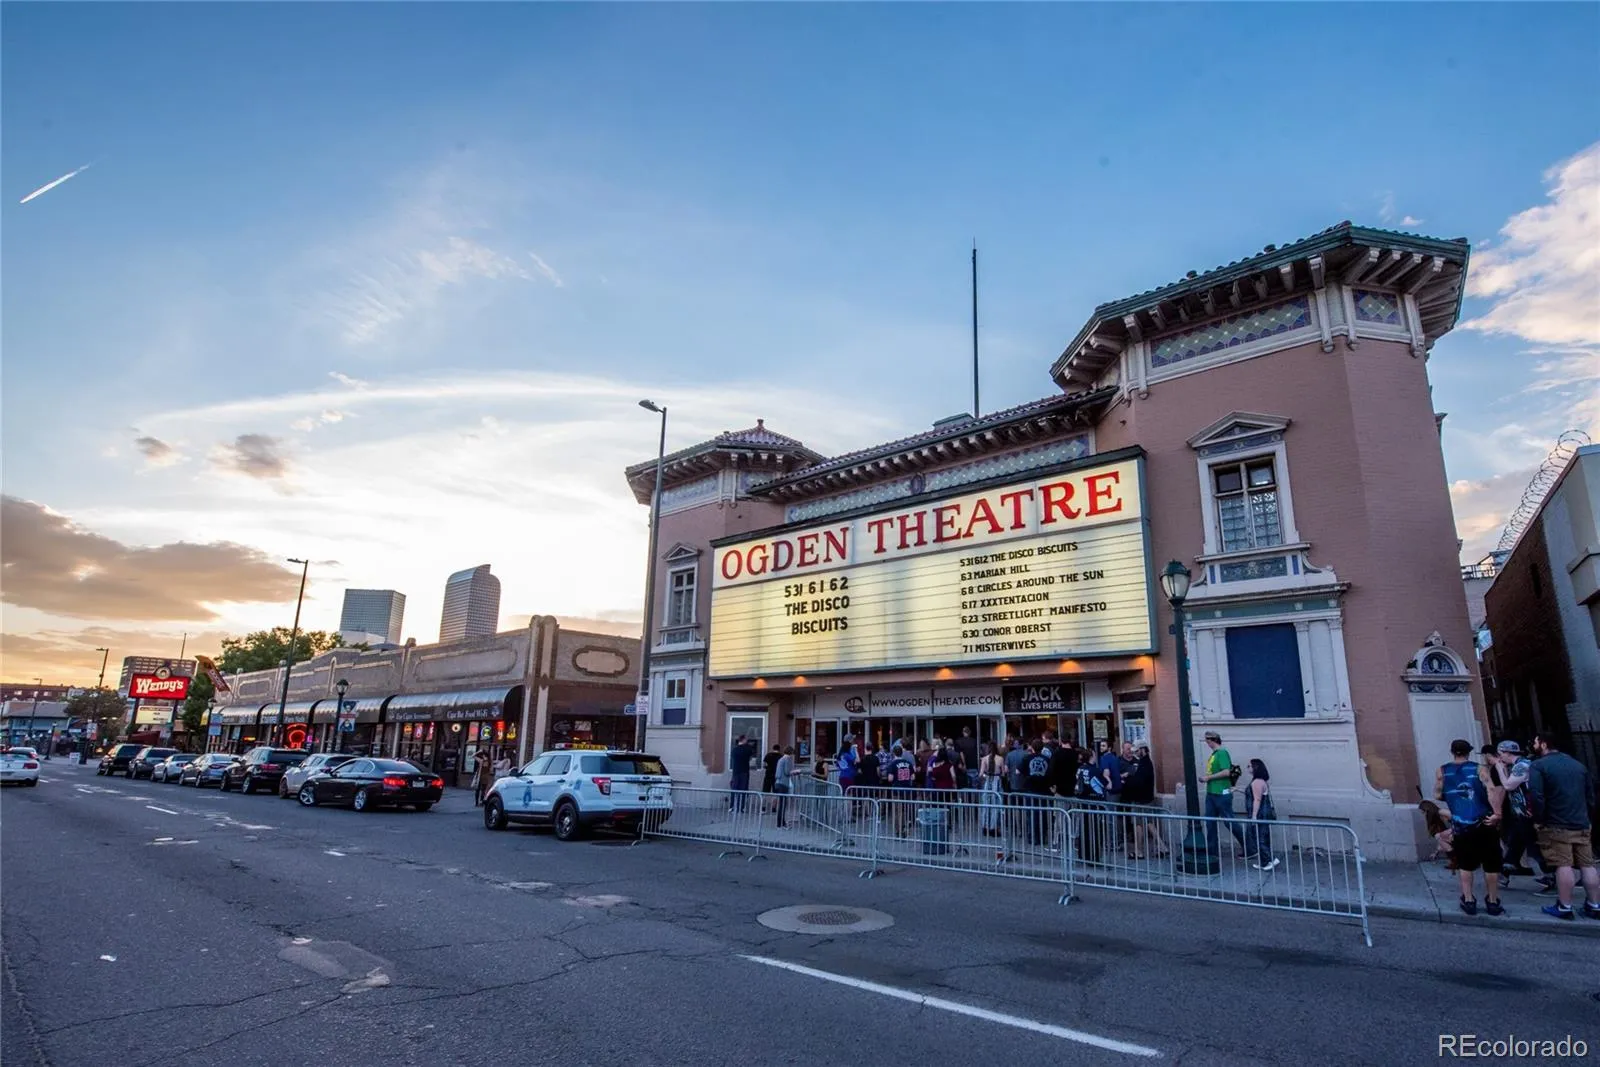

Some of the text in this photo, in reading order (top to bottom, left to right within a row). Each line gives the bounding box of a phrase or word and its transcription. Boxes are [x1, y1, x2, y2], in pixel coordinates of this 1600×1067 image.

[721, 470, 1123, 580] OGDEN THEATRE
[990, 552, 1006, 562] THE
[1008, 548, 1034, 560] DISCO
[1037, 541, 1078, 556] BISCUITS
[974, 567, 1006, 579] MARIAN
[1010, 564, 1030, 574] HILL
[977, 582, 1013, 593] CIRCLES
[1016, 576, 1055, 588] AROUND
[1060, 573, 1079, 583] THE
[1083, 569, 1104, 580] SUN
[784, 595, 850, 616] THE DISCO
[980, 592, 1050, 607] XXXTENTACION
[961, 601, 1107, 624] 623 STREETLIGHT MANIFESTO
[791, 616, 848, 635] BISCUITS
[962, 622, 1052, 638] 630 CONOR OBERST
[975, 639, 1036, 652] MISTERWIVES
[1020, 686, 1062, 702] JACK
[1021, 702, 1042, 711] LIVES
